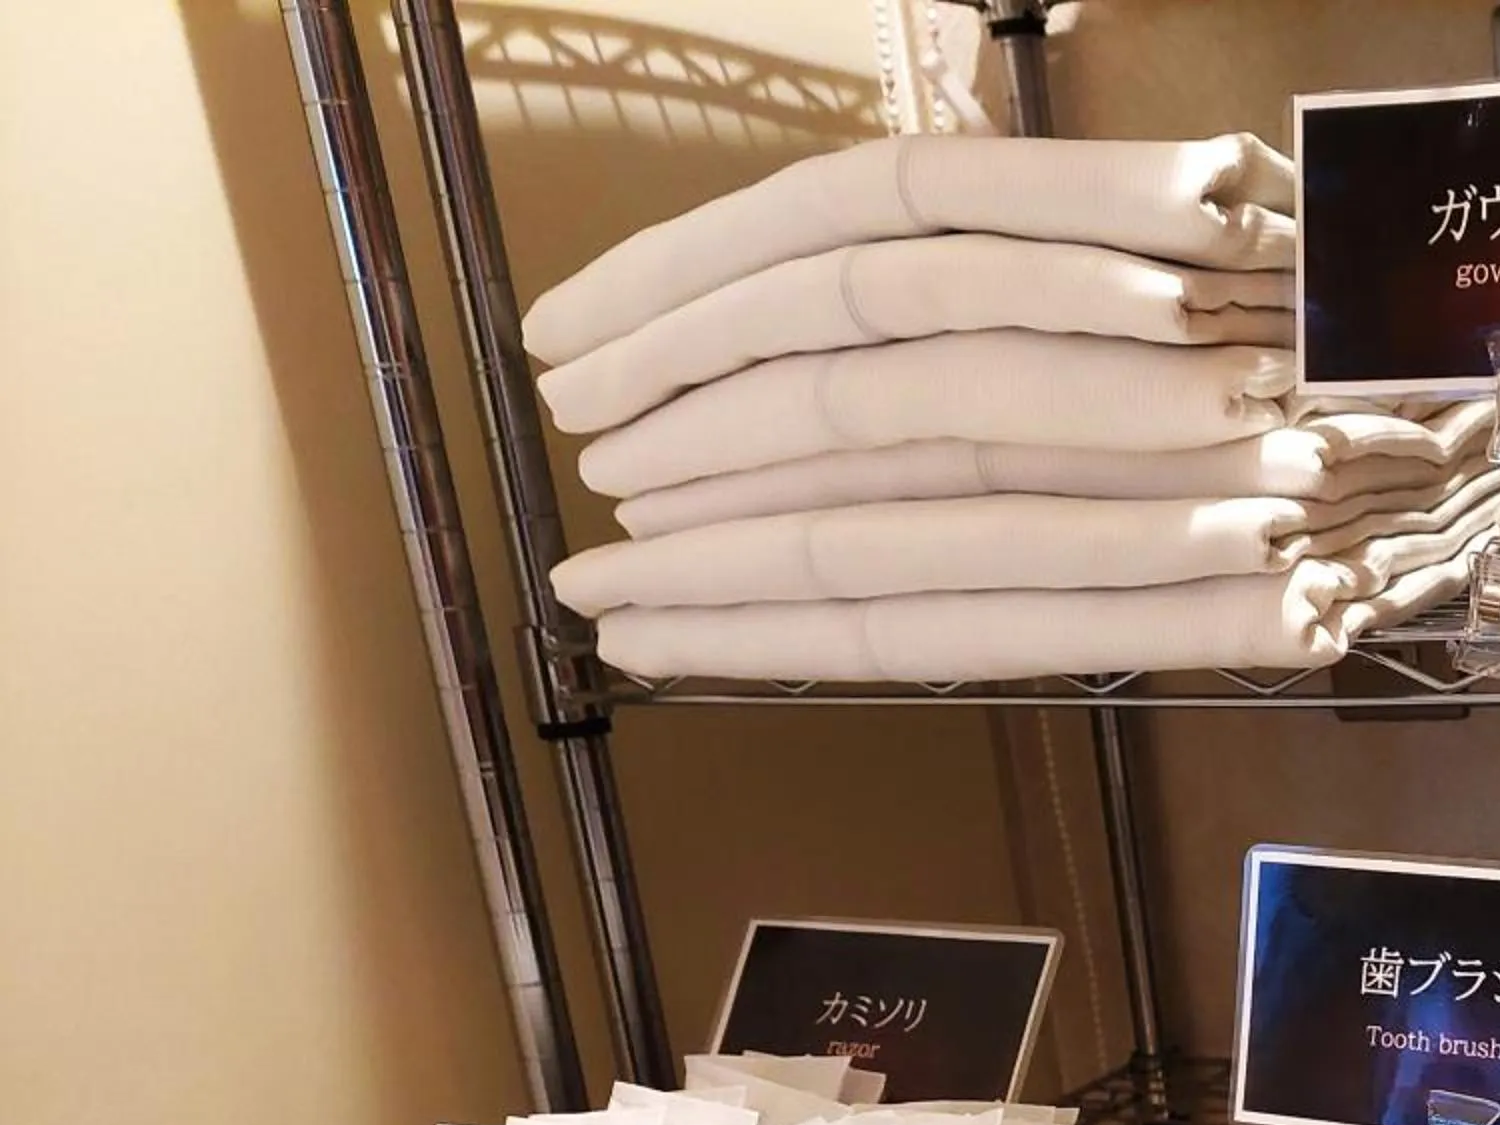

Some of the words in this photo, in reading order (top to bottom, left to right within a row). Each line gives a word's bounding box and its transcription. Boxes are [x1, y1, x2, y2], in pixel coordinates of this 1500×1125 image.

[816, 991, 928, 1032] カミソリ
[1366, 1025, 1431, 1053] Tooth
